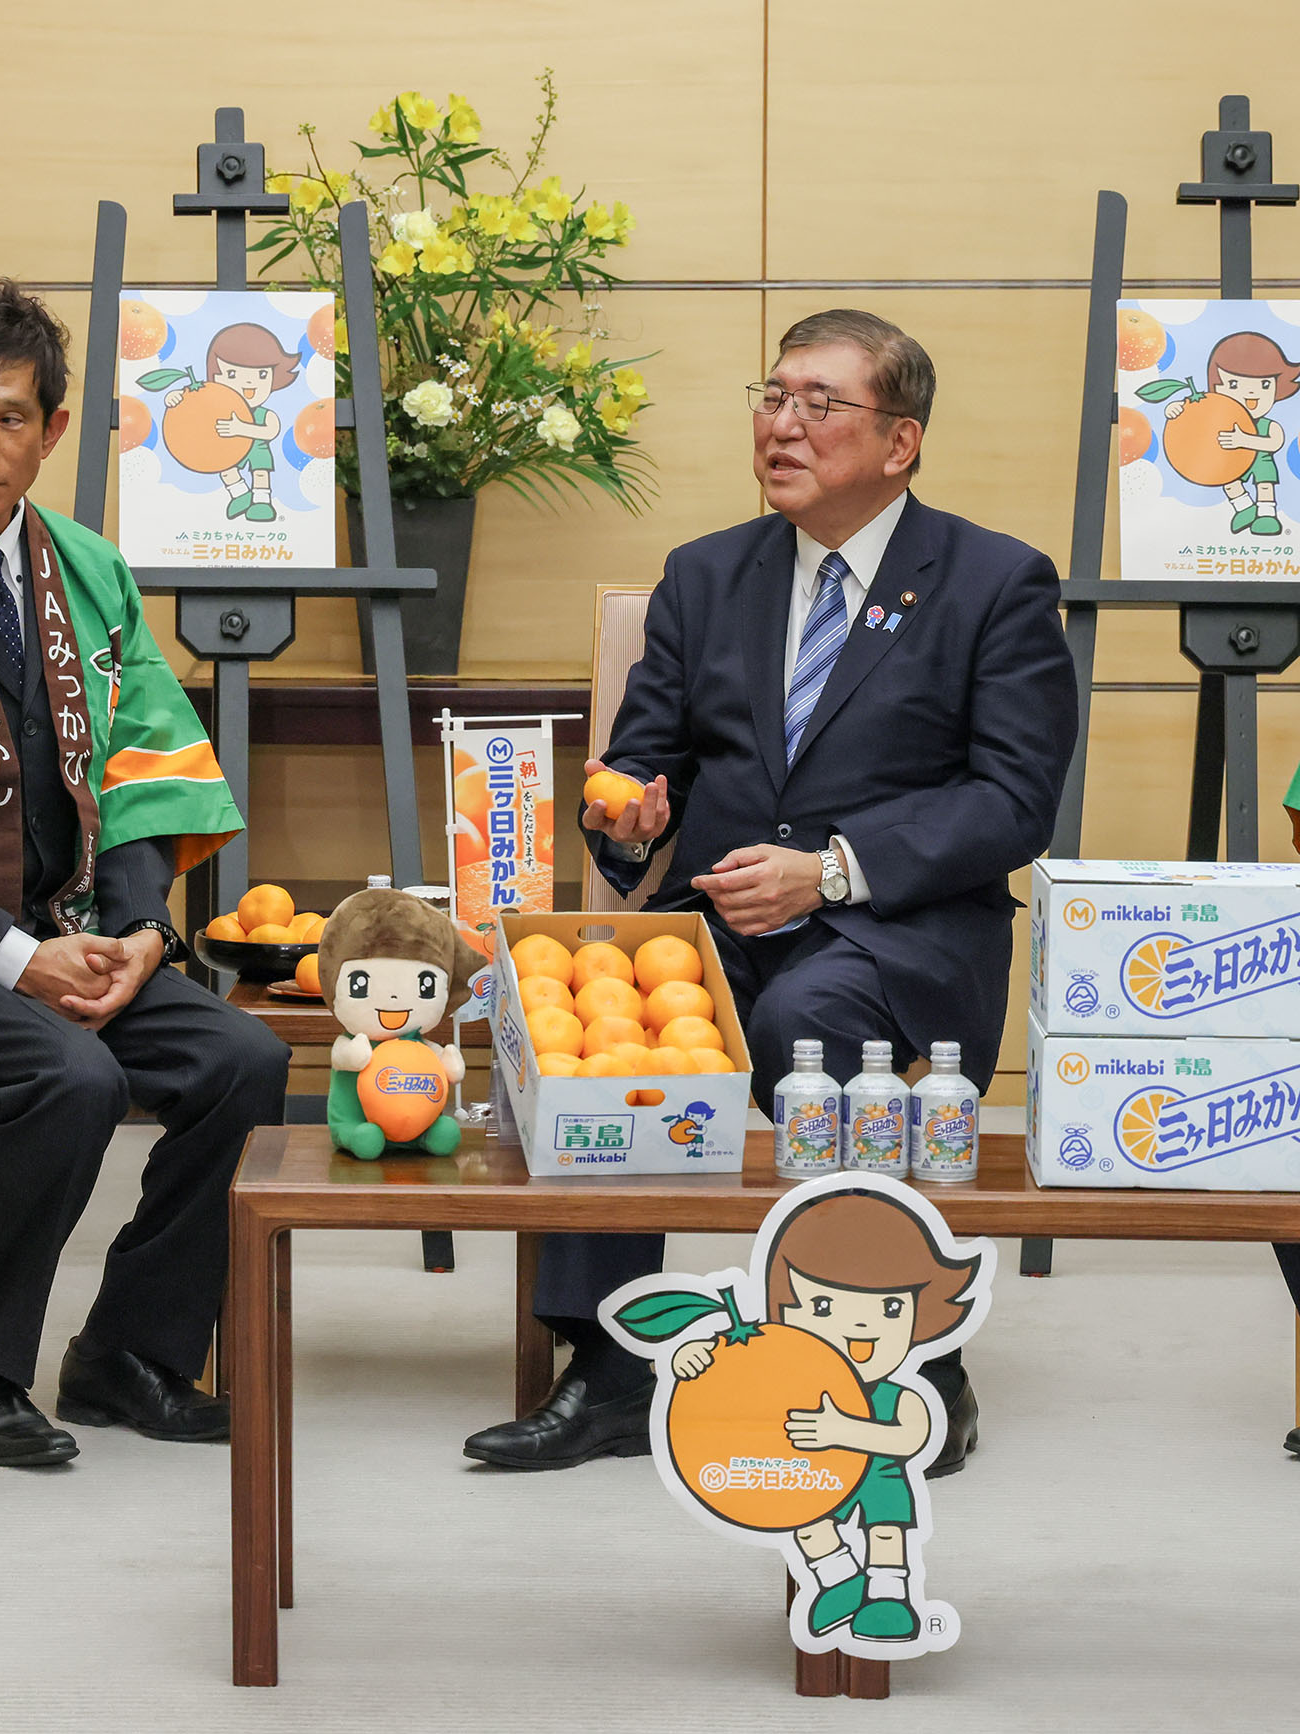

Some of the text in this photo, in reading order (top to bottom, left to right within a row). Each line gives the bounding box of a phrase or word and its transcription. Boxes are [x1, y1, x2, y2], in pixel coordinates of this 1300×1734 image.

[192, 531, 287, 541] ミカちゃんマークの
[1196, 545, 1294, 556] ミカちゃんマークの
[40, 548, 93, 786] JAみっかび
[1101, 906, 1171, 921] mikkabi
[1180, 904, 1219, 922] 青島
[1161, 927, 1300, 1010] 三ヶ日みか
[1095, 1060, 1165, 1075] mikkabi
[1174, 1057, 1213, 1076] 青島
[1155, 1081, 1300, 1163] 三ヶ日みか
[564, 1124, 624, 1148] 青島
[575, 1153, 627, 1165] mikkabi
[731, 1458, 809, 1468] ミカちゃんマークの
